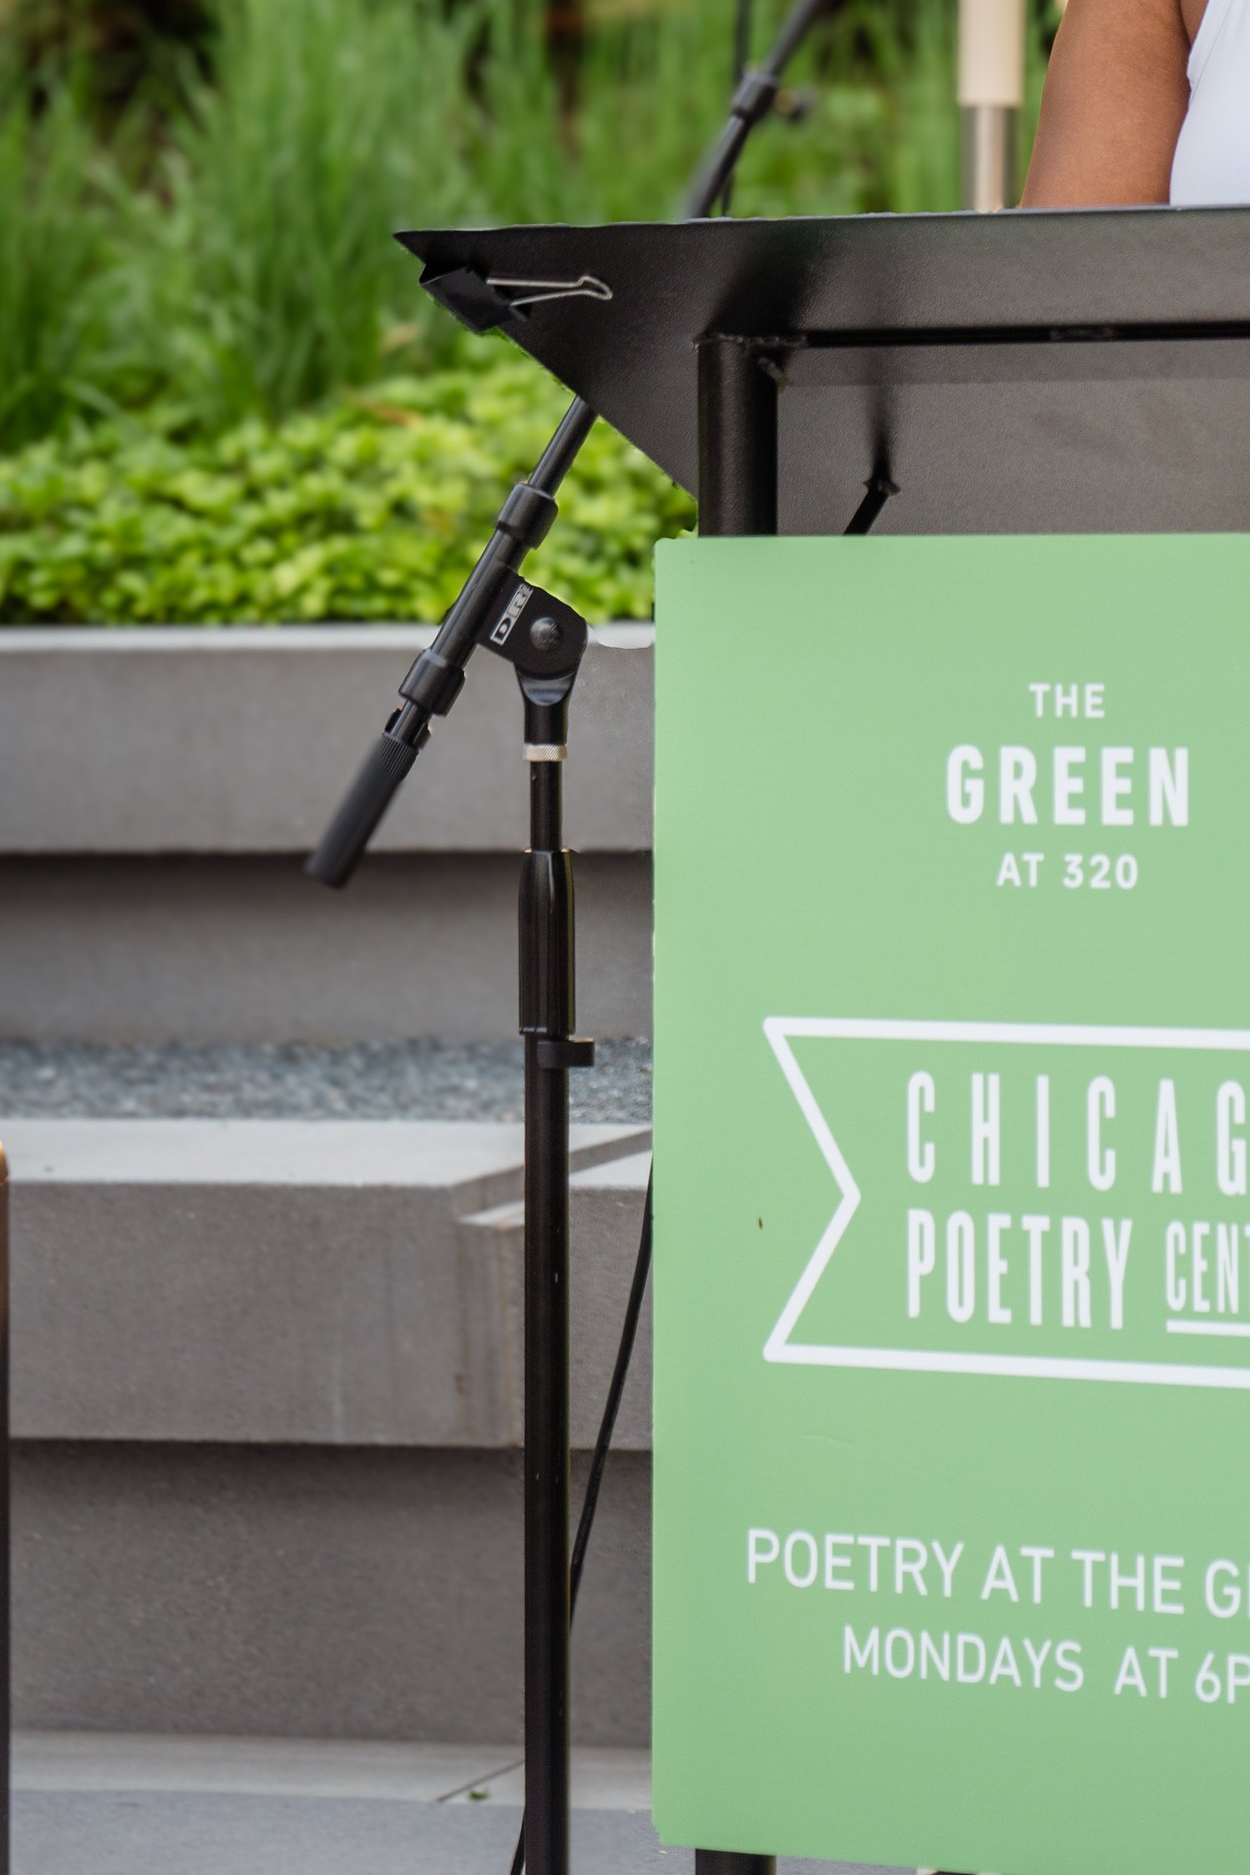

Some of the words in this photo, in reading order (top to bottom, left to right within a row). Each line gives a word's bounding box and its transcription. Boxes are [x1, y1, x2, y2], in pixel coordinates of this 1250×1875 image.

[1028, 682, 1106, 719] THE
[945, 744, 1190, 828] GREEN
[996, 852, 1045, 888] AT
[1061, 853, 1139, 890] 320
[907, 1208, 1133, 1331] POETRY
[747, 1527, 965, 1599] POETRY
[980, 1544, 1055, 1605] AT
[1071, 1550, 1186, 1616] THE
[842, 1625, 1086, 1693] MONDAYS
[1113, 1646, 1179, 1699] AT
